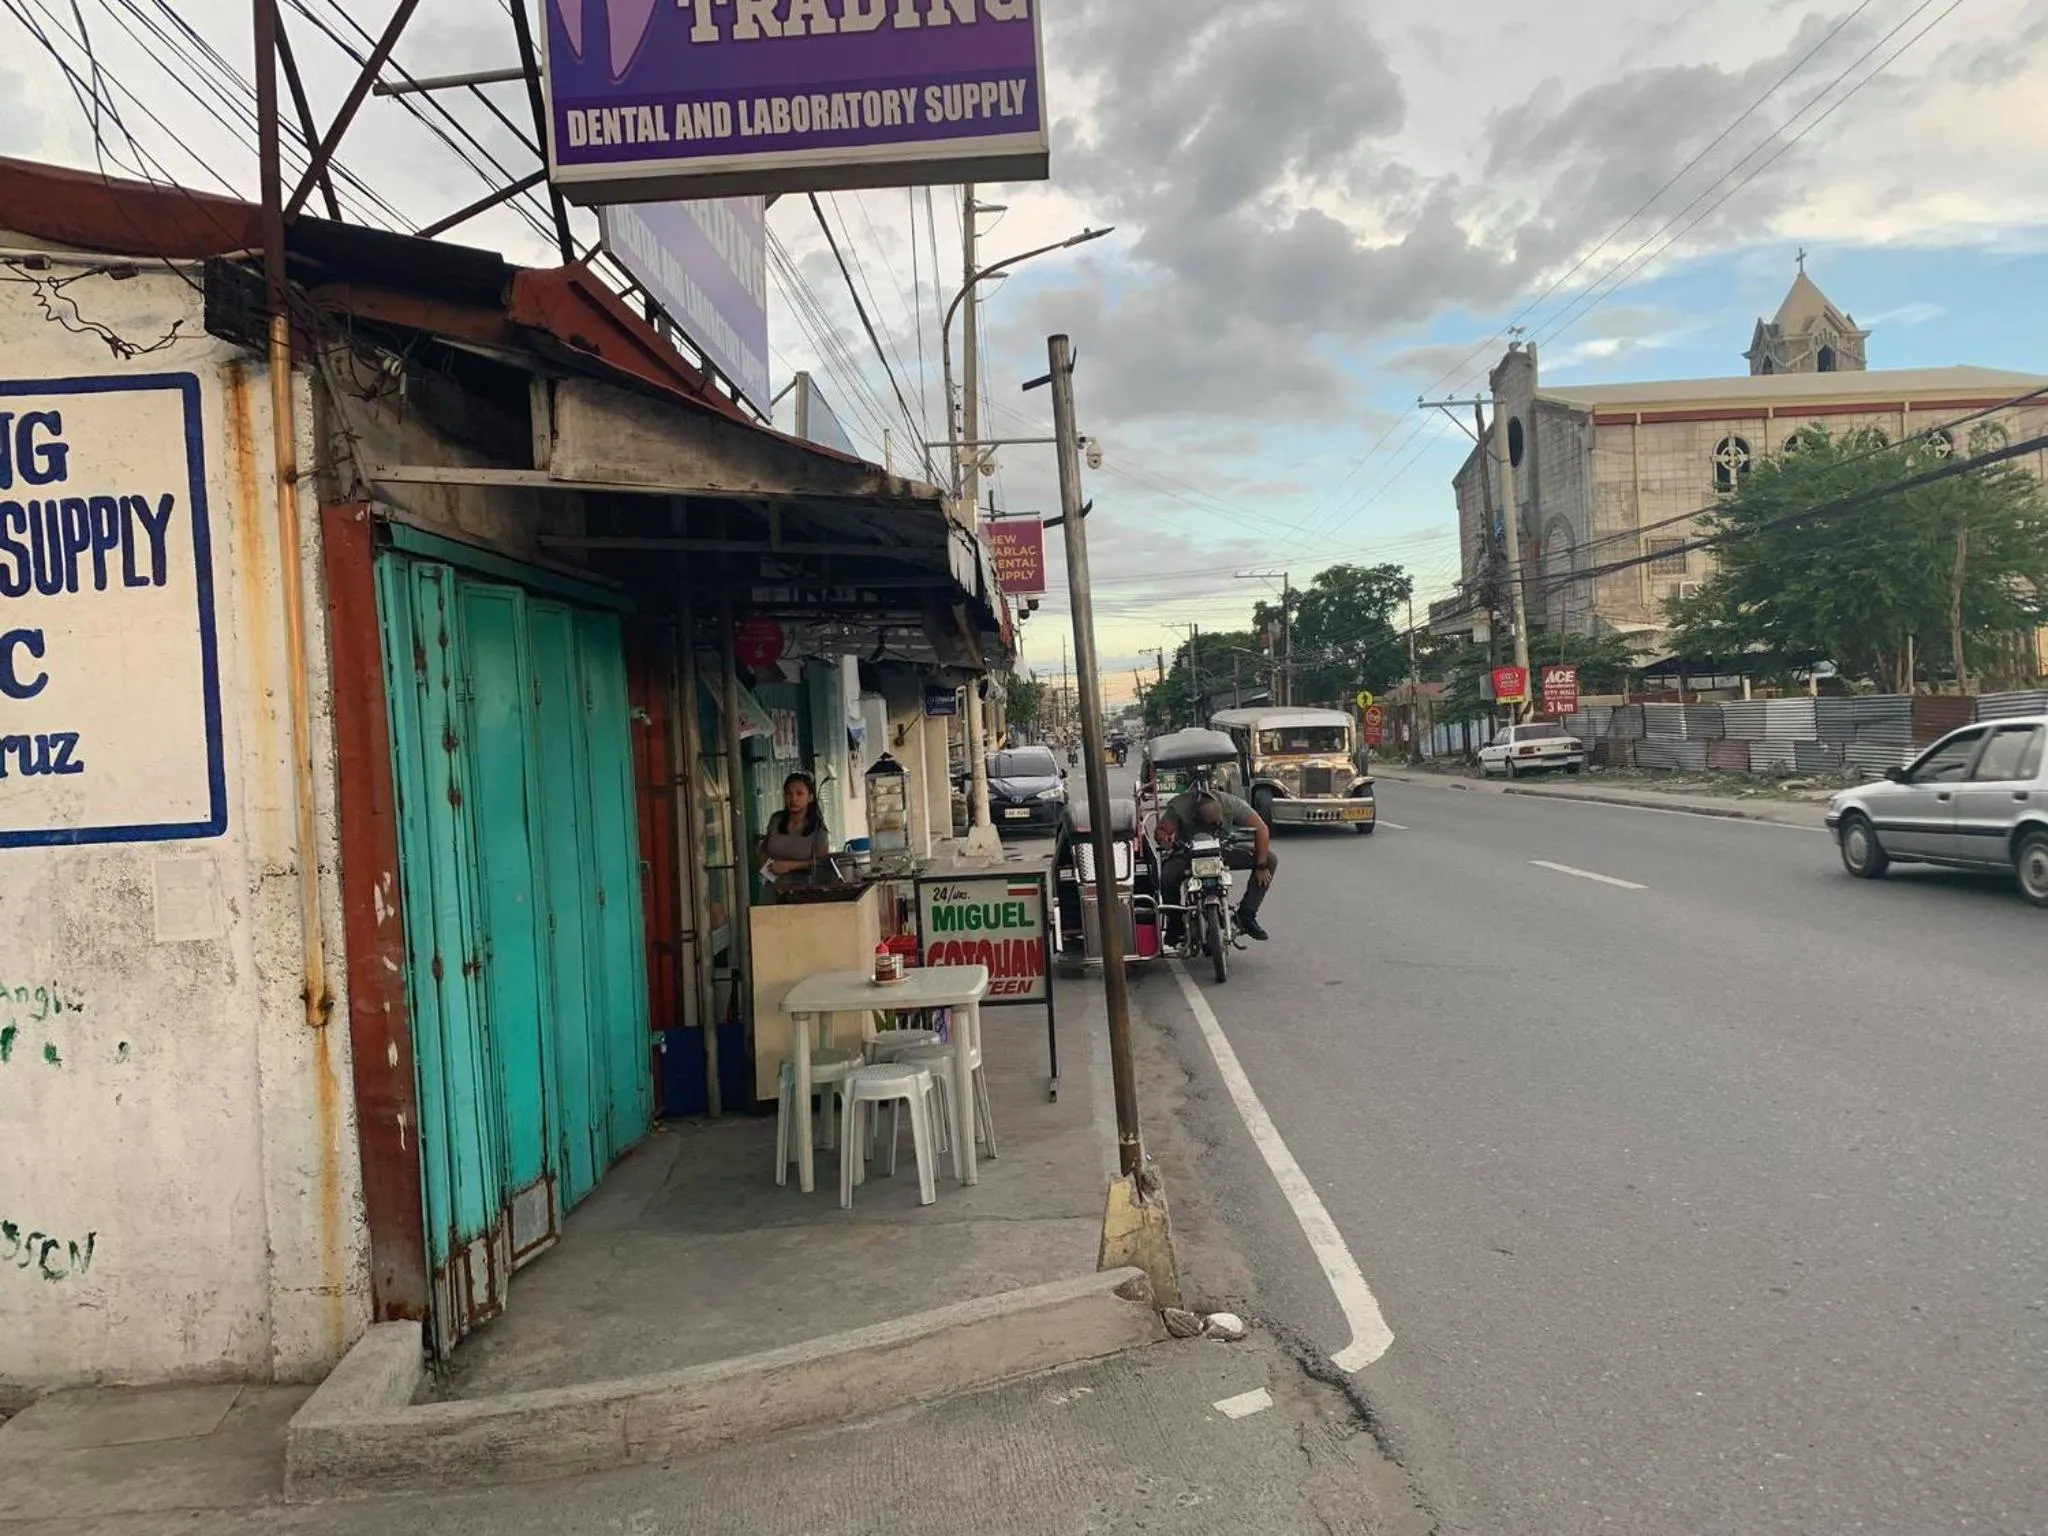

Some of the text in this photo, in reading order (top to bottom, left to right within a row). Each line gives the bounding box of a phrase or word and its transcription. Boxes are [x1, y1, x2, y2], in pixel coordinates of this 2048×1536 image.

[568, 79, 1027, 147] DENTAL AND LABORATORY SUPPLY
[1545, 669, 1575, 683] ACE
[1547, 701, 1574, 713] 3 km
[931, 902, 1035, 932] MIGUEL
